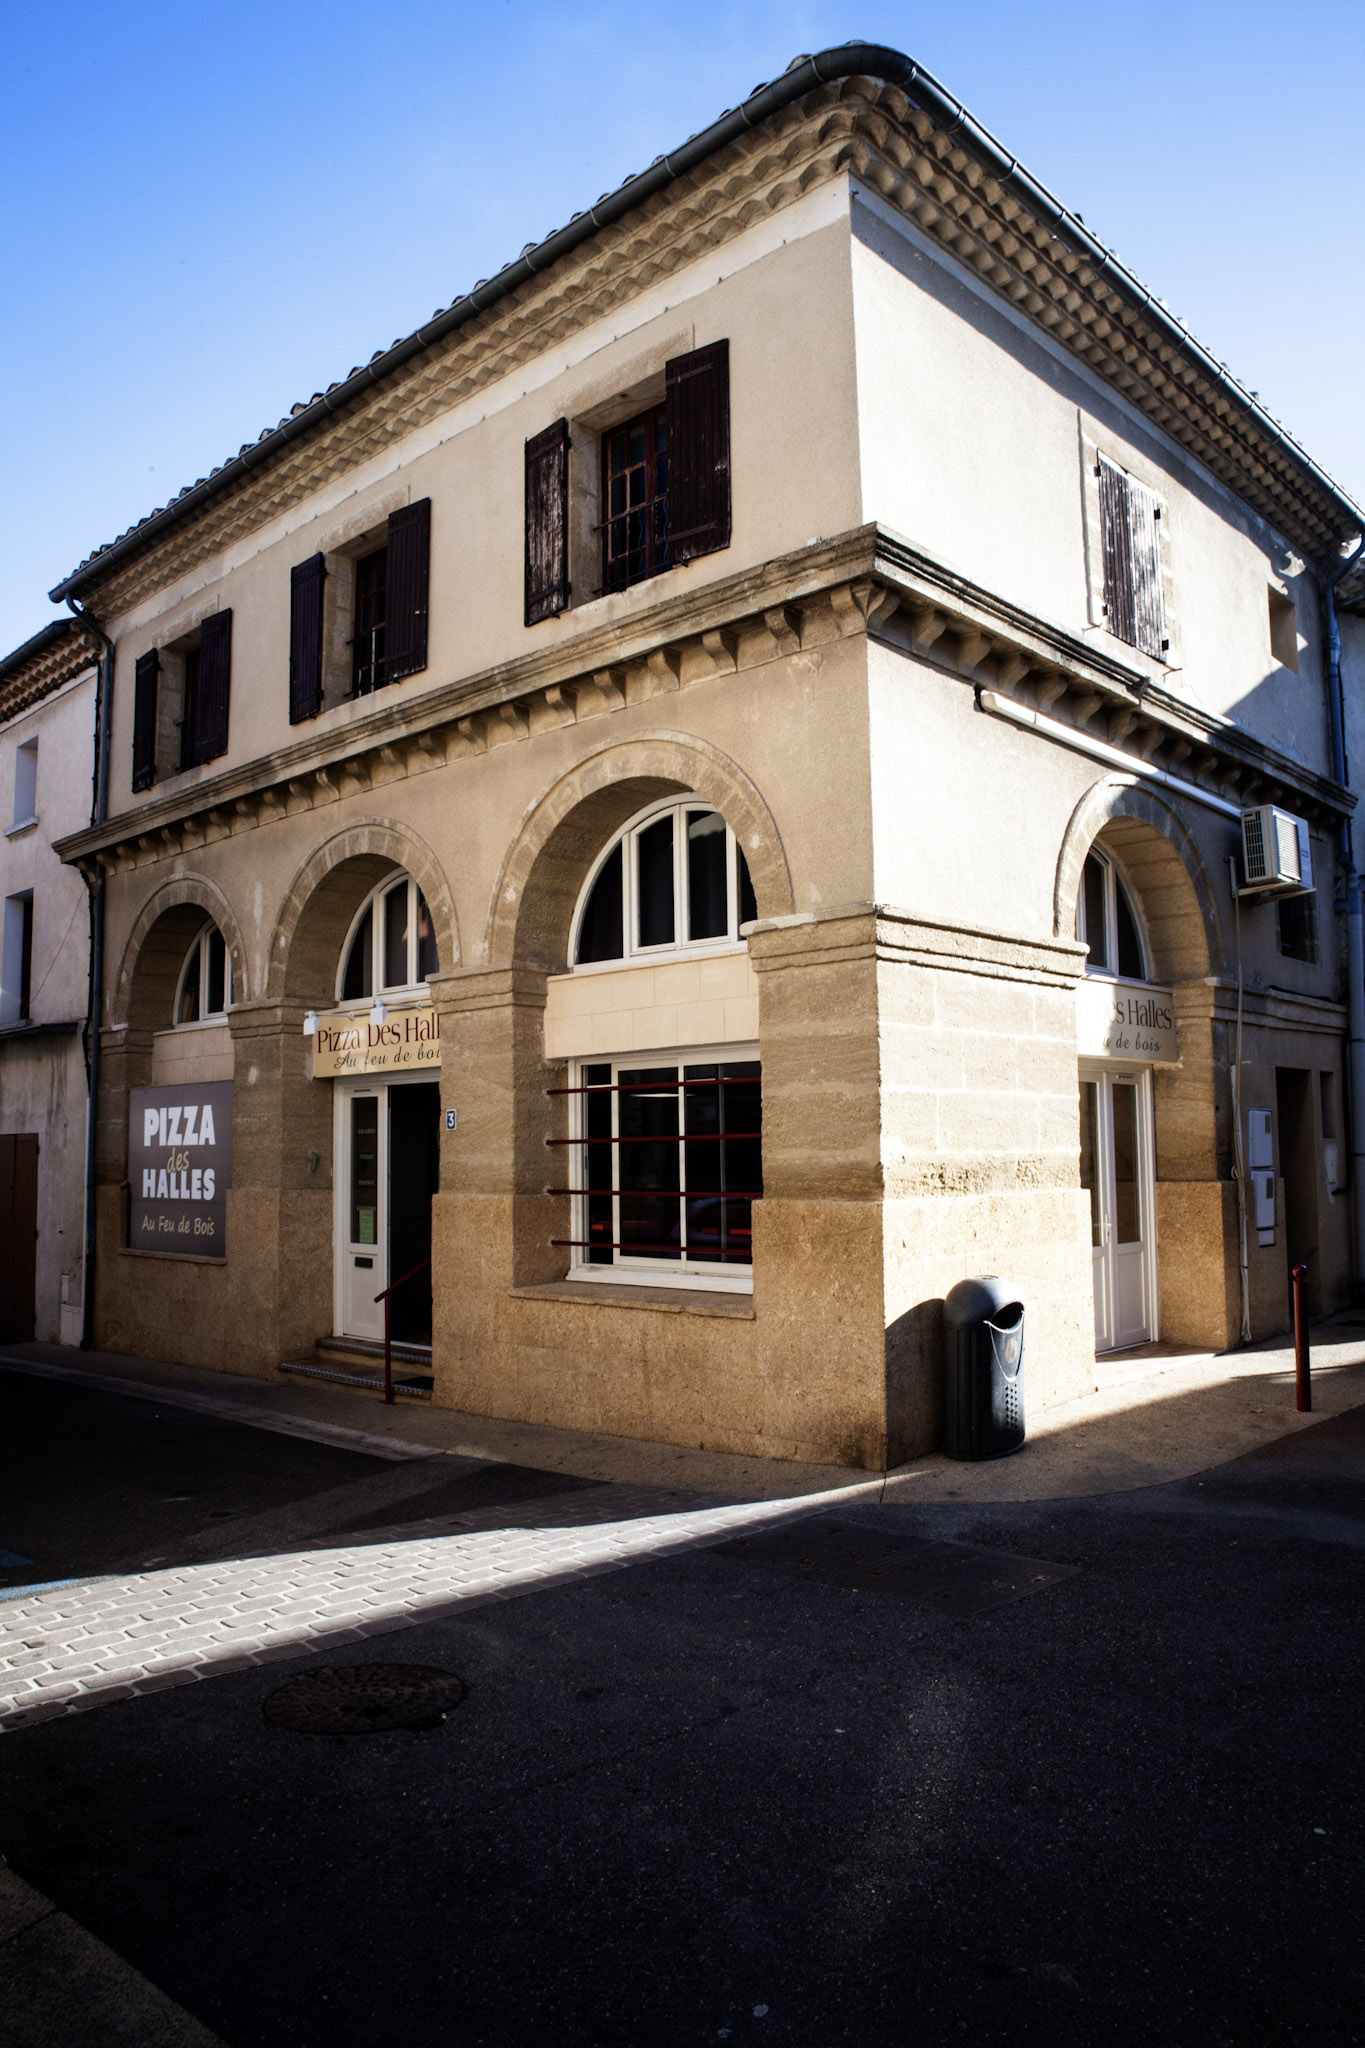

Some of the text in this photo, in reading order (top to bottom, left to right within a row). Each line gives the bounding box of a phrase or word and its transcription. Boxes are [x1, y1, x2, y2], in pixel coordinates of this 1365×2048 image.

[1127, 998, 1172, 1031] Halles
[318, 1026, 360, 1053] Pizza
[367, 1022, 401, 1047] Des
[1116, 1031, 1132, 1050] de
[1135, 1032, 1162, 1052] bois
[333, 1050, 359, 1070] Au
[363, 1048, 389, 1073] feu
[393, 1045, 413, 1063] de
[144, 1104, 216, 1147] PIZZA
[447, 1112, 455, 1128] 3
[166, 1147, 190, 1173] des
[142, 1168, 216, 1201] HALLES
[141, 1214, 215, 1236] Au Feu de Bois
